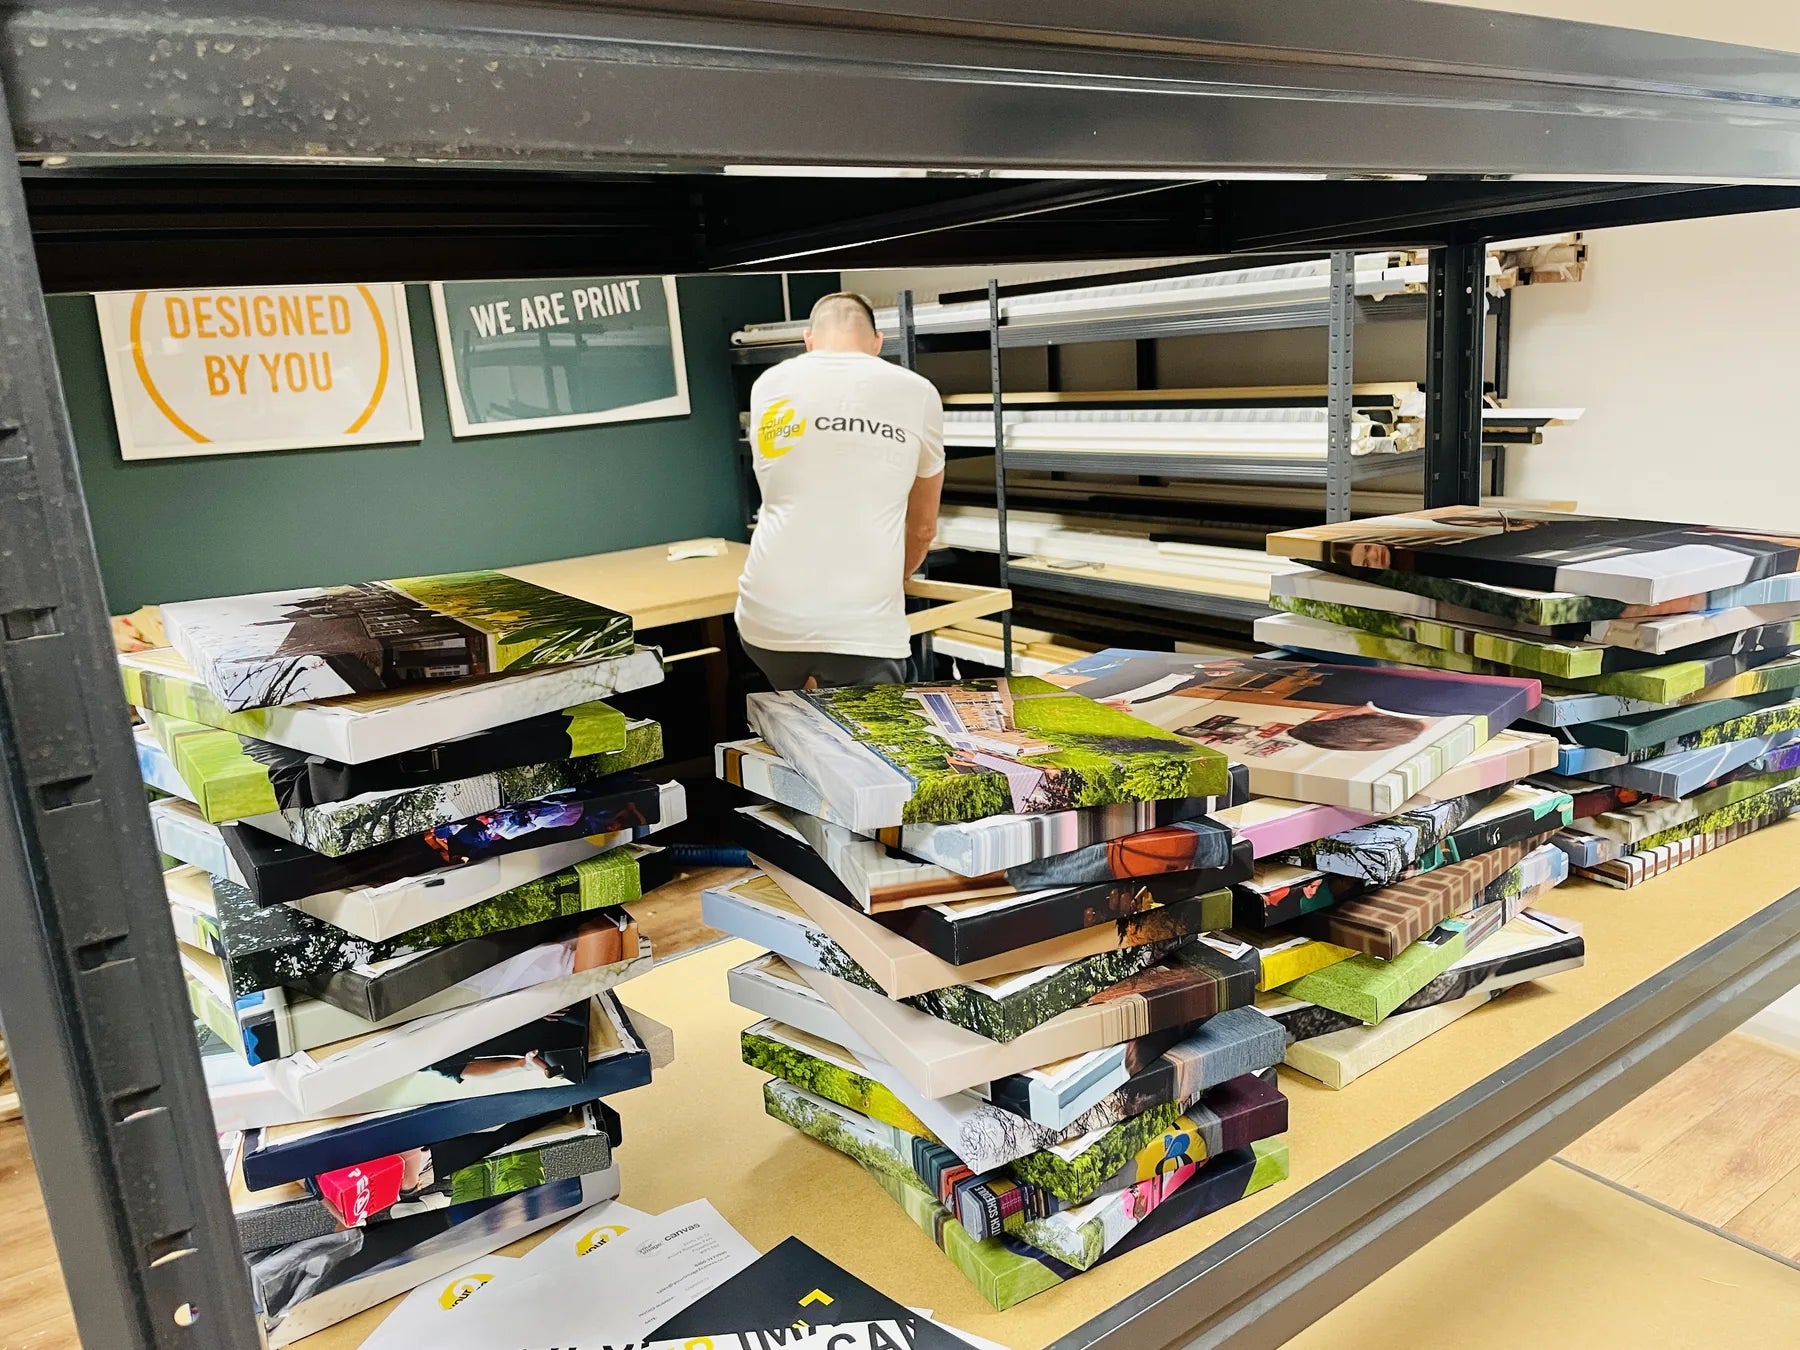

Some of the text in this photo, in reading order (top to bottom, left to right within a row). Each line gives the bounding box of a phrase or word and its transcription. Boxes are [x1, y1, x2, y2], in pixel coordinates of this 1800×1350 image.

[164, 294, 351, 339] DESIGNED
[470, 280, 641, 338] WE ARE PRINT
[204, 351, 333, 396] BY YOU
[814, 416, 906, 443] canvas
[664, 1222, 701, 1241] canvas
